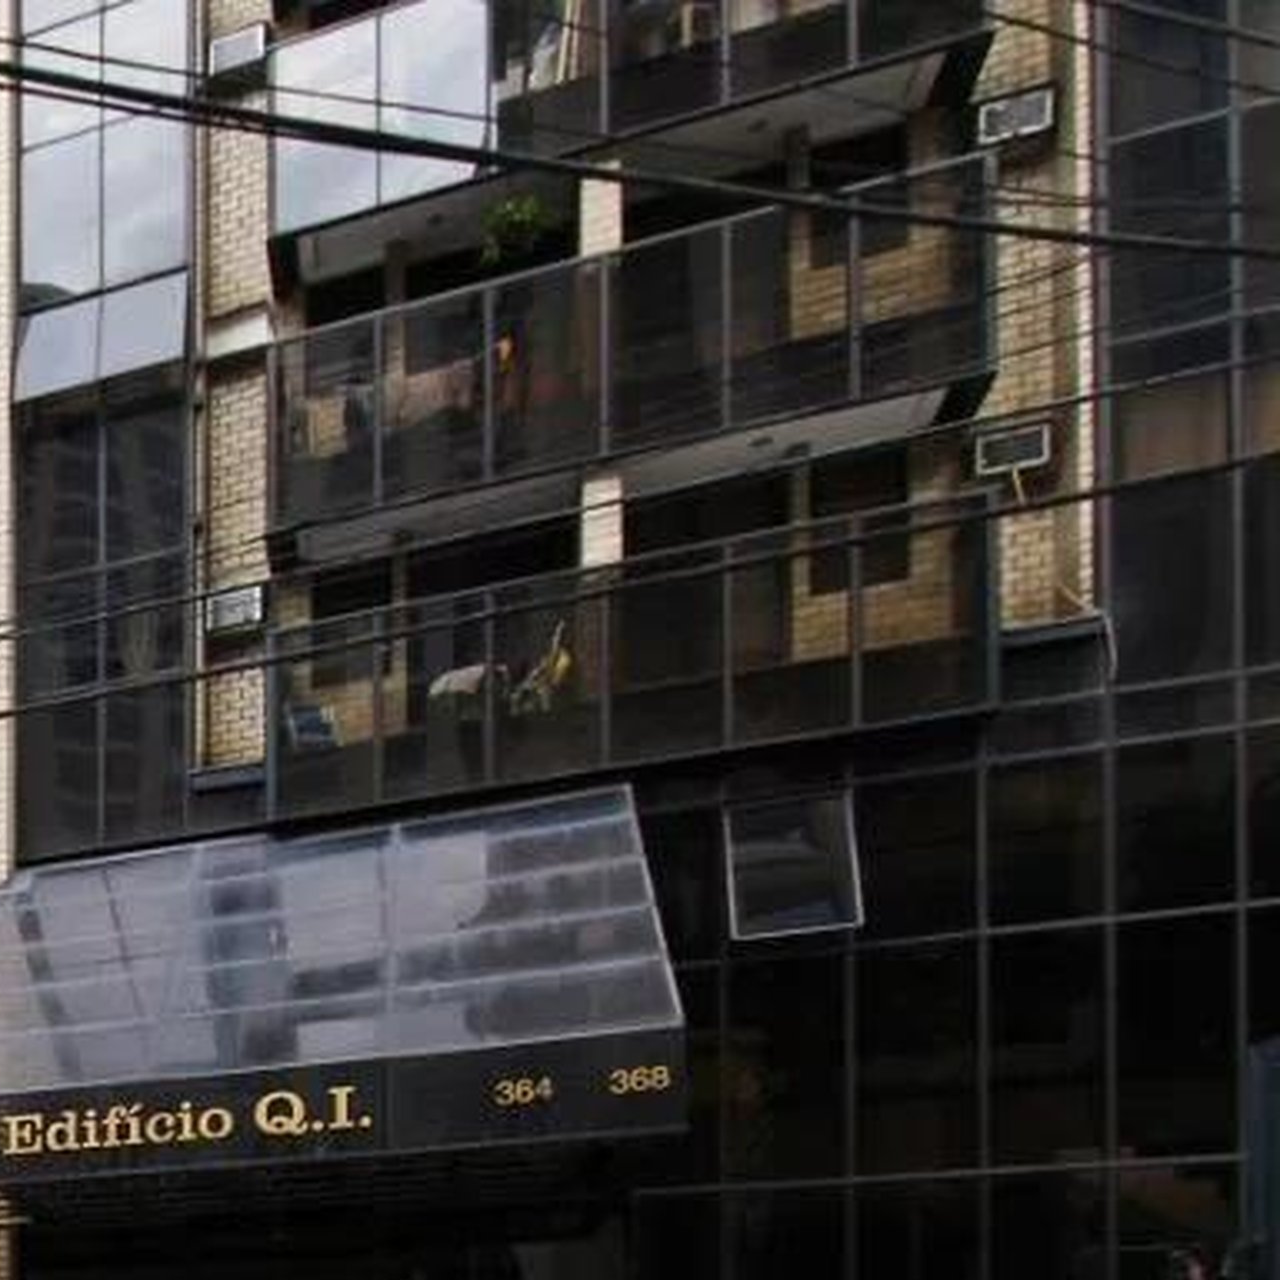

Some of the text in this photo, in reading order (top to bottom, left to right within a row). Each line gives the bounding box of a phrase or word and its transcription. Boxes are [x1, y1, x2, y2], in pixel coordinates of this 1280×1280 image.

[494, 1065, 671, 1106] 364 368
[1, 1086, 372, 1155] Edifício Q.I.
